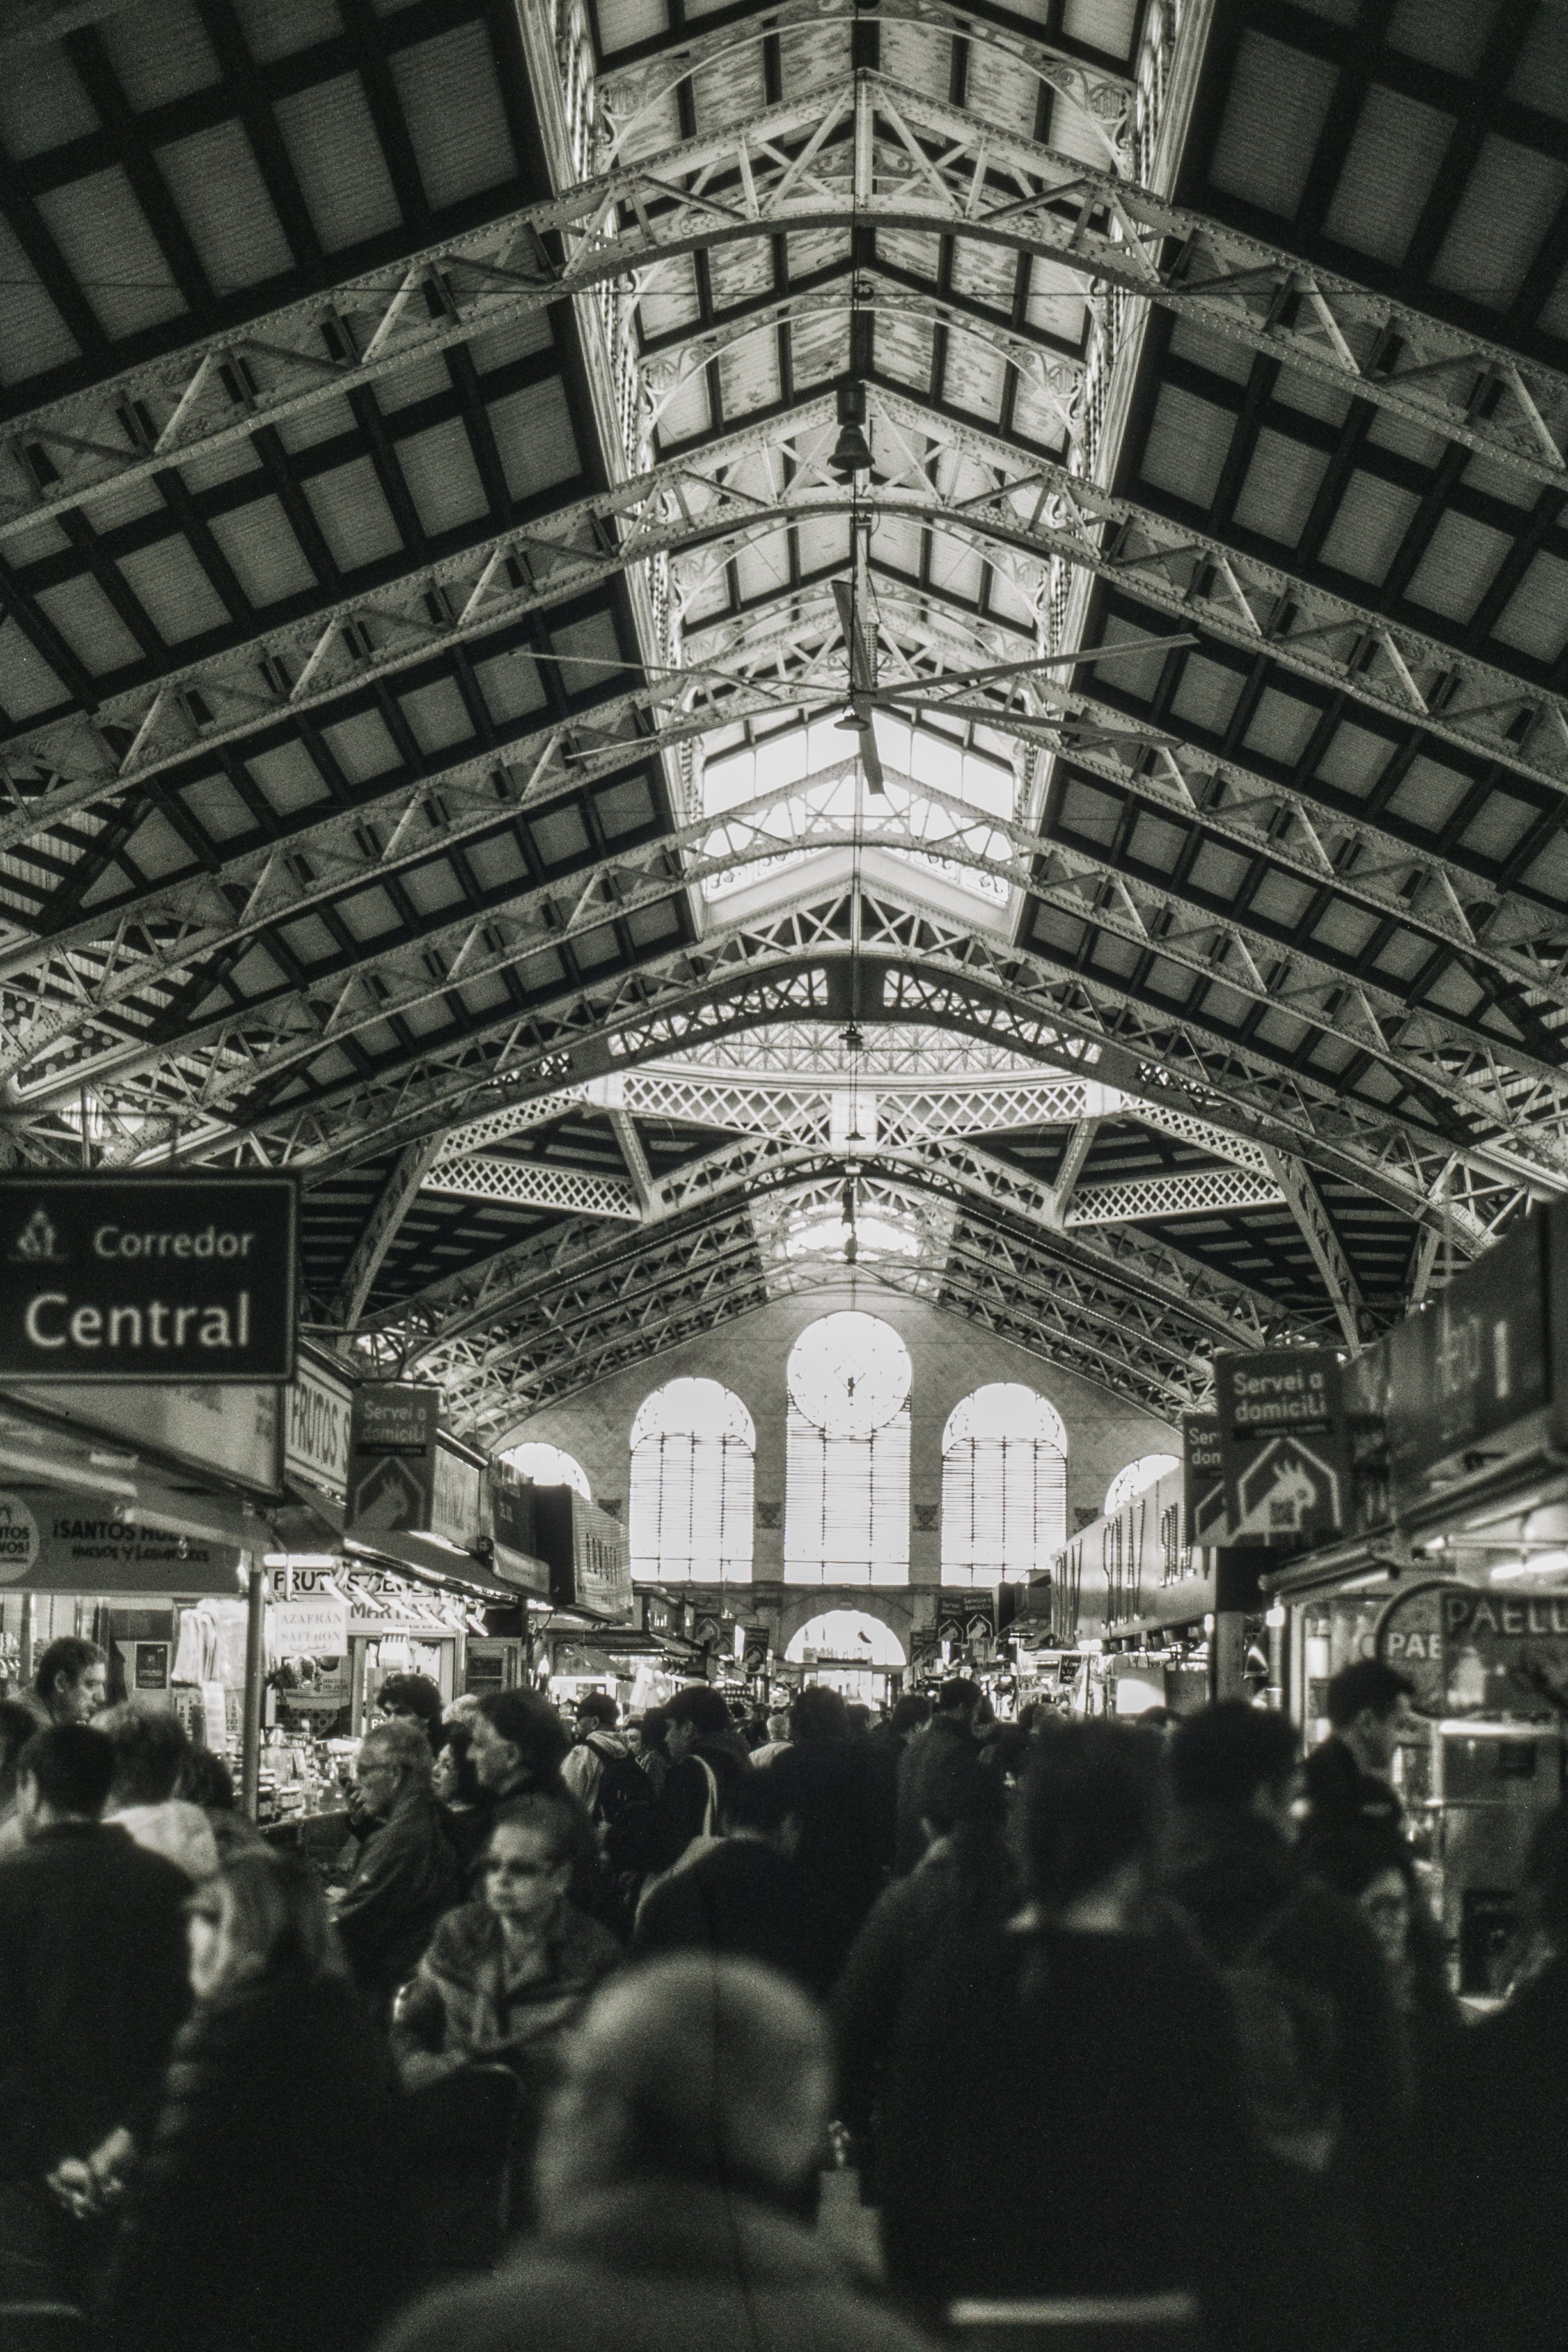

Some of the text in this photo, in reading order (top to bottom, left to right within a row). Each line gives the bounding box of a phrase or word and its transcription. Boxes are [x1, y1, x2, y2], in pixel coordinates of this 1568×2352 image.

[93, 1225, 255, 1258] Corredor
[25, 1290, 249, 1347] Central
[1233, 1369, 1304, 1396] Servei
[364, 1400, 413, 1420] Servei
[1235, 1393, 1327, 1422] domicili
[290, 1382, 338, 1468] FRUTOS
[362, 1423, 426, 1443] domicili
[274, 1571, 360, 1592] FRUTS
[281, 1611, 341, 1624] AZAFRÁN
[281, 1631, 341, 1642] SAFFRON
